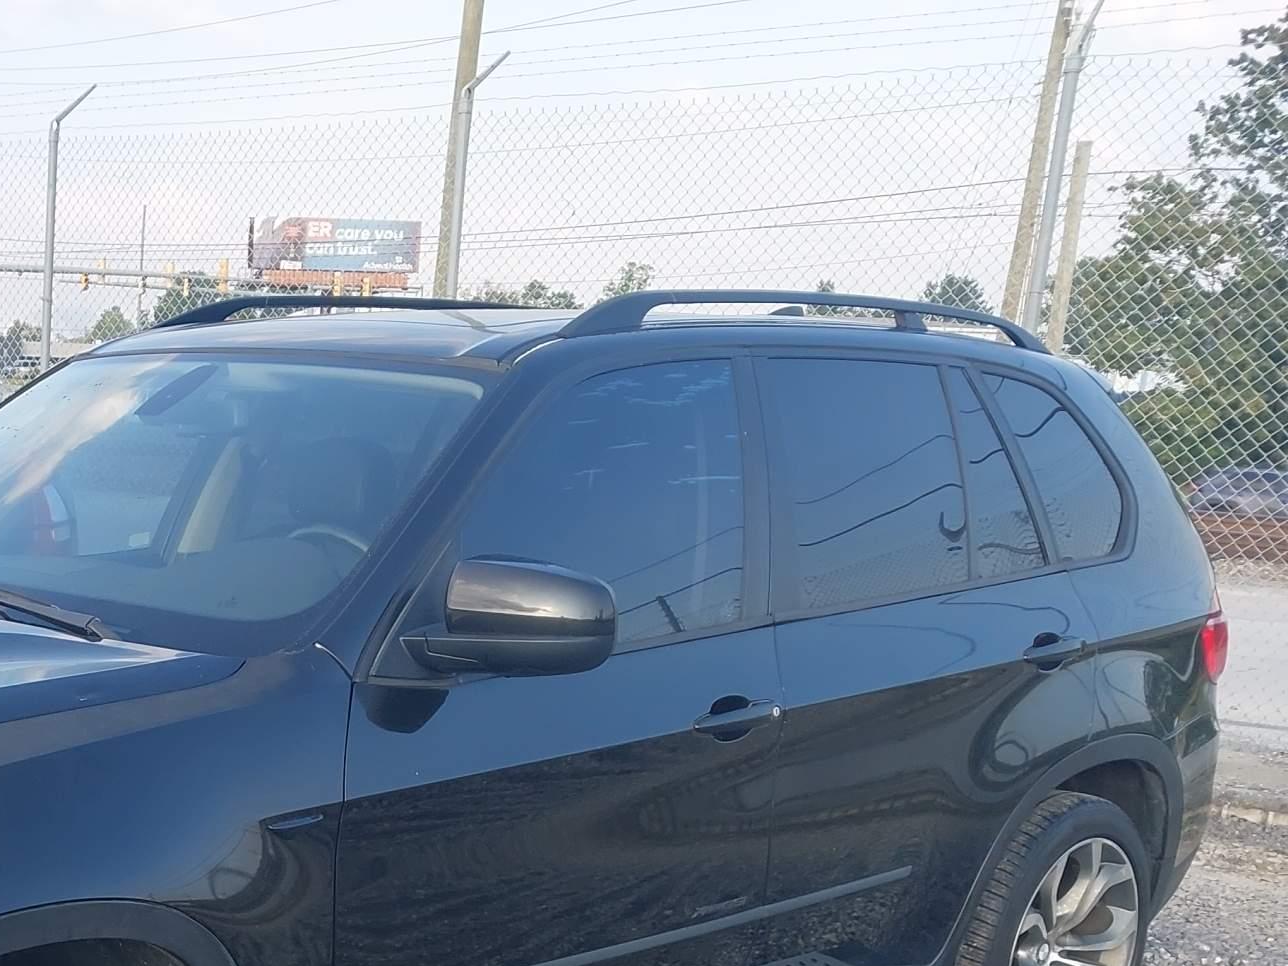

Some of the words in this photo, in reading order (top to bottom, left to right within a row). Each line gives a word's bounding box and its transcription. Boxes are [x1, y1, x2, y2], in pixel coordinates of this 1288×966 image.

[307, 221, 332, 238] ER
[335, 228, 370, 240] care
[374, 229, 404, 243] you
[305, 243, 333, 254] can
